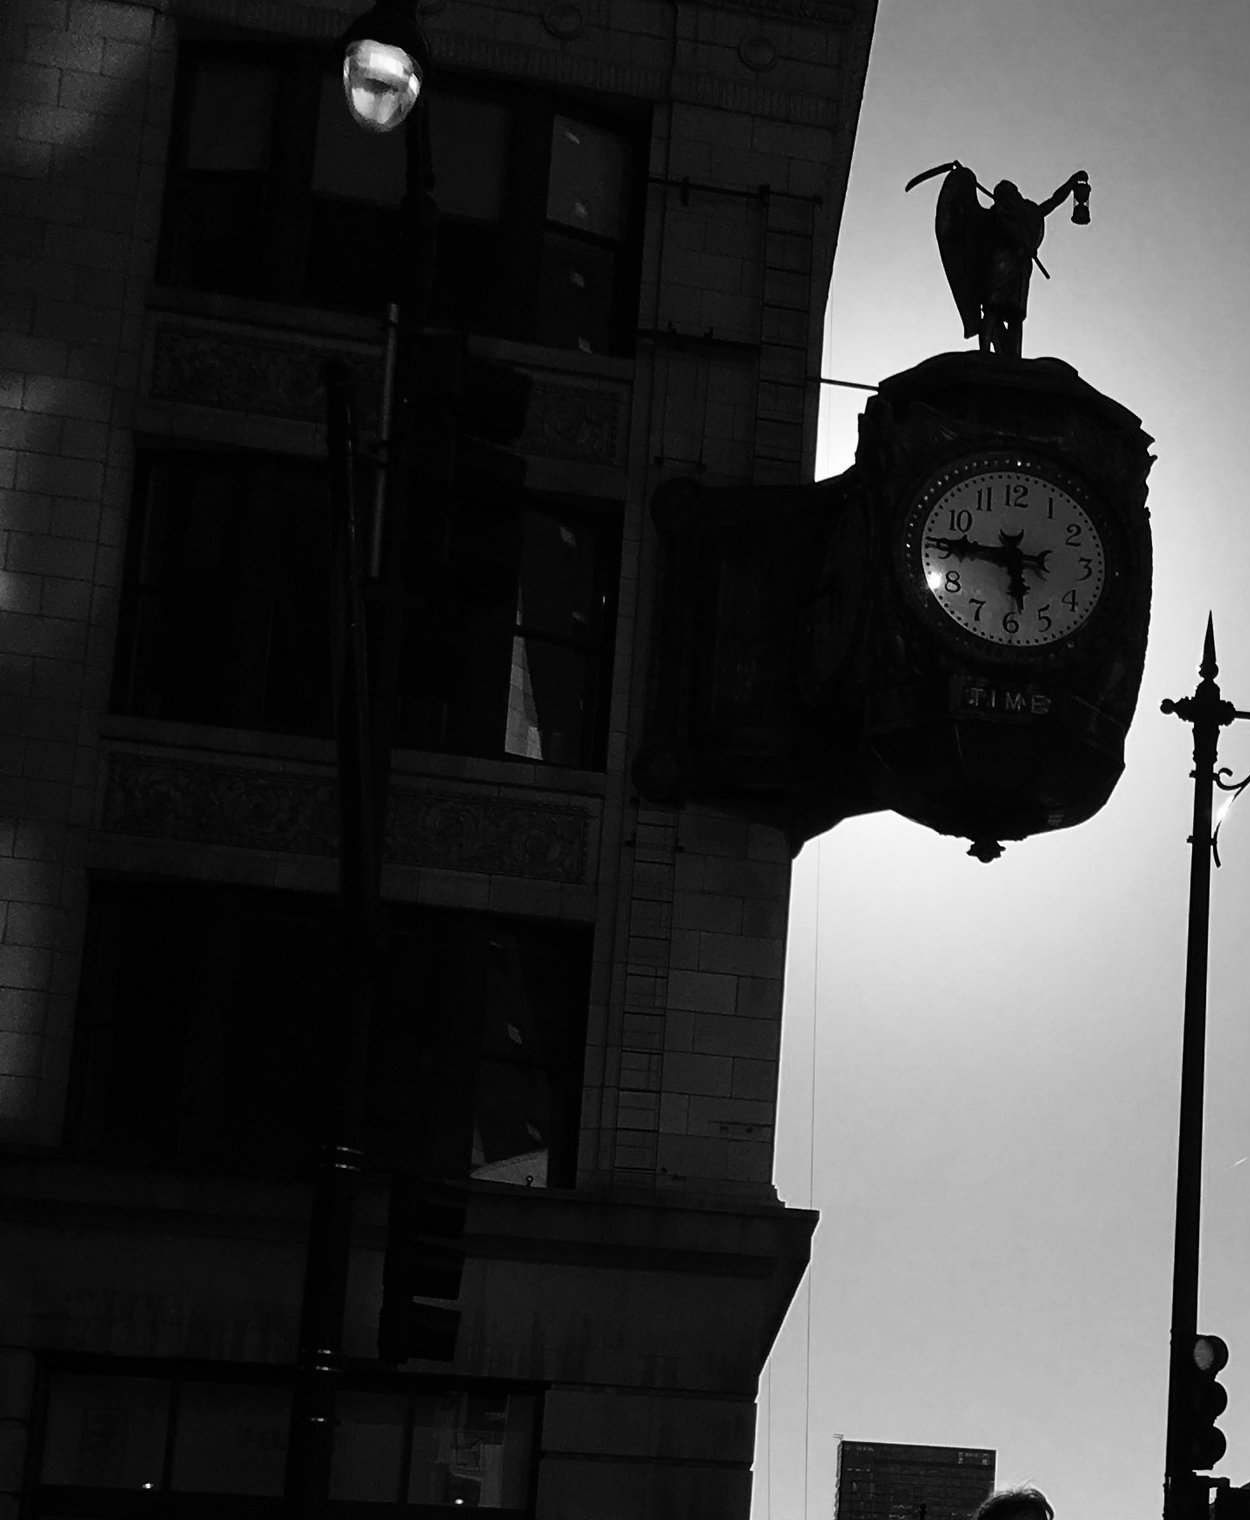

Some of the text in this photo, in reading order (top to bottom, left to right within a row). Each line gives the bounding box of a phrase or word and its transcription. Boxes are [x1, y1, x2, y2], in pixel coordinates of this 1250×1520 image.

[976, 487, 993, 512] 11
[1004, 484, 1029, 508] 12
[1047, 497, 1054, 520] 1
[949, 509, 973, 533] 10
[1065, 523, 1082, 547] 2
[1076, 557, 1093, 581] 3
[944, 570, 961, 593] 8
[968, 598, 986, 622] 7
[1061, 589, 1079, 613] 4
[1002, 611, 1020, 634] 6
[1037, 603, 1053, 633] 5
[968, 686, 1050, 716] TIME
